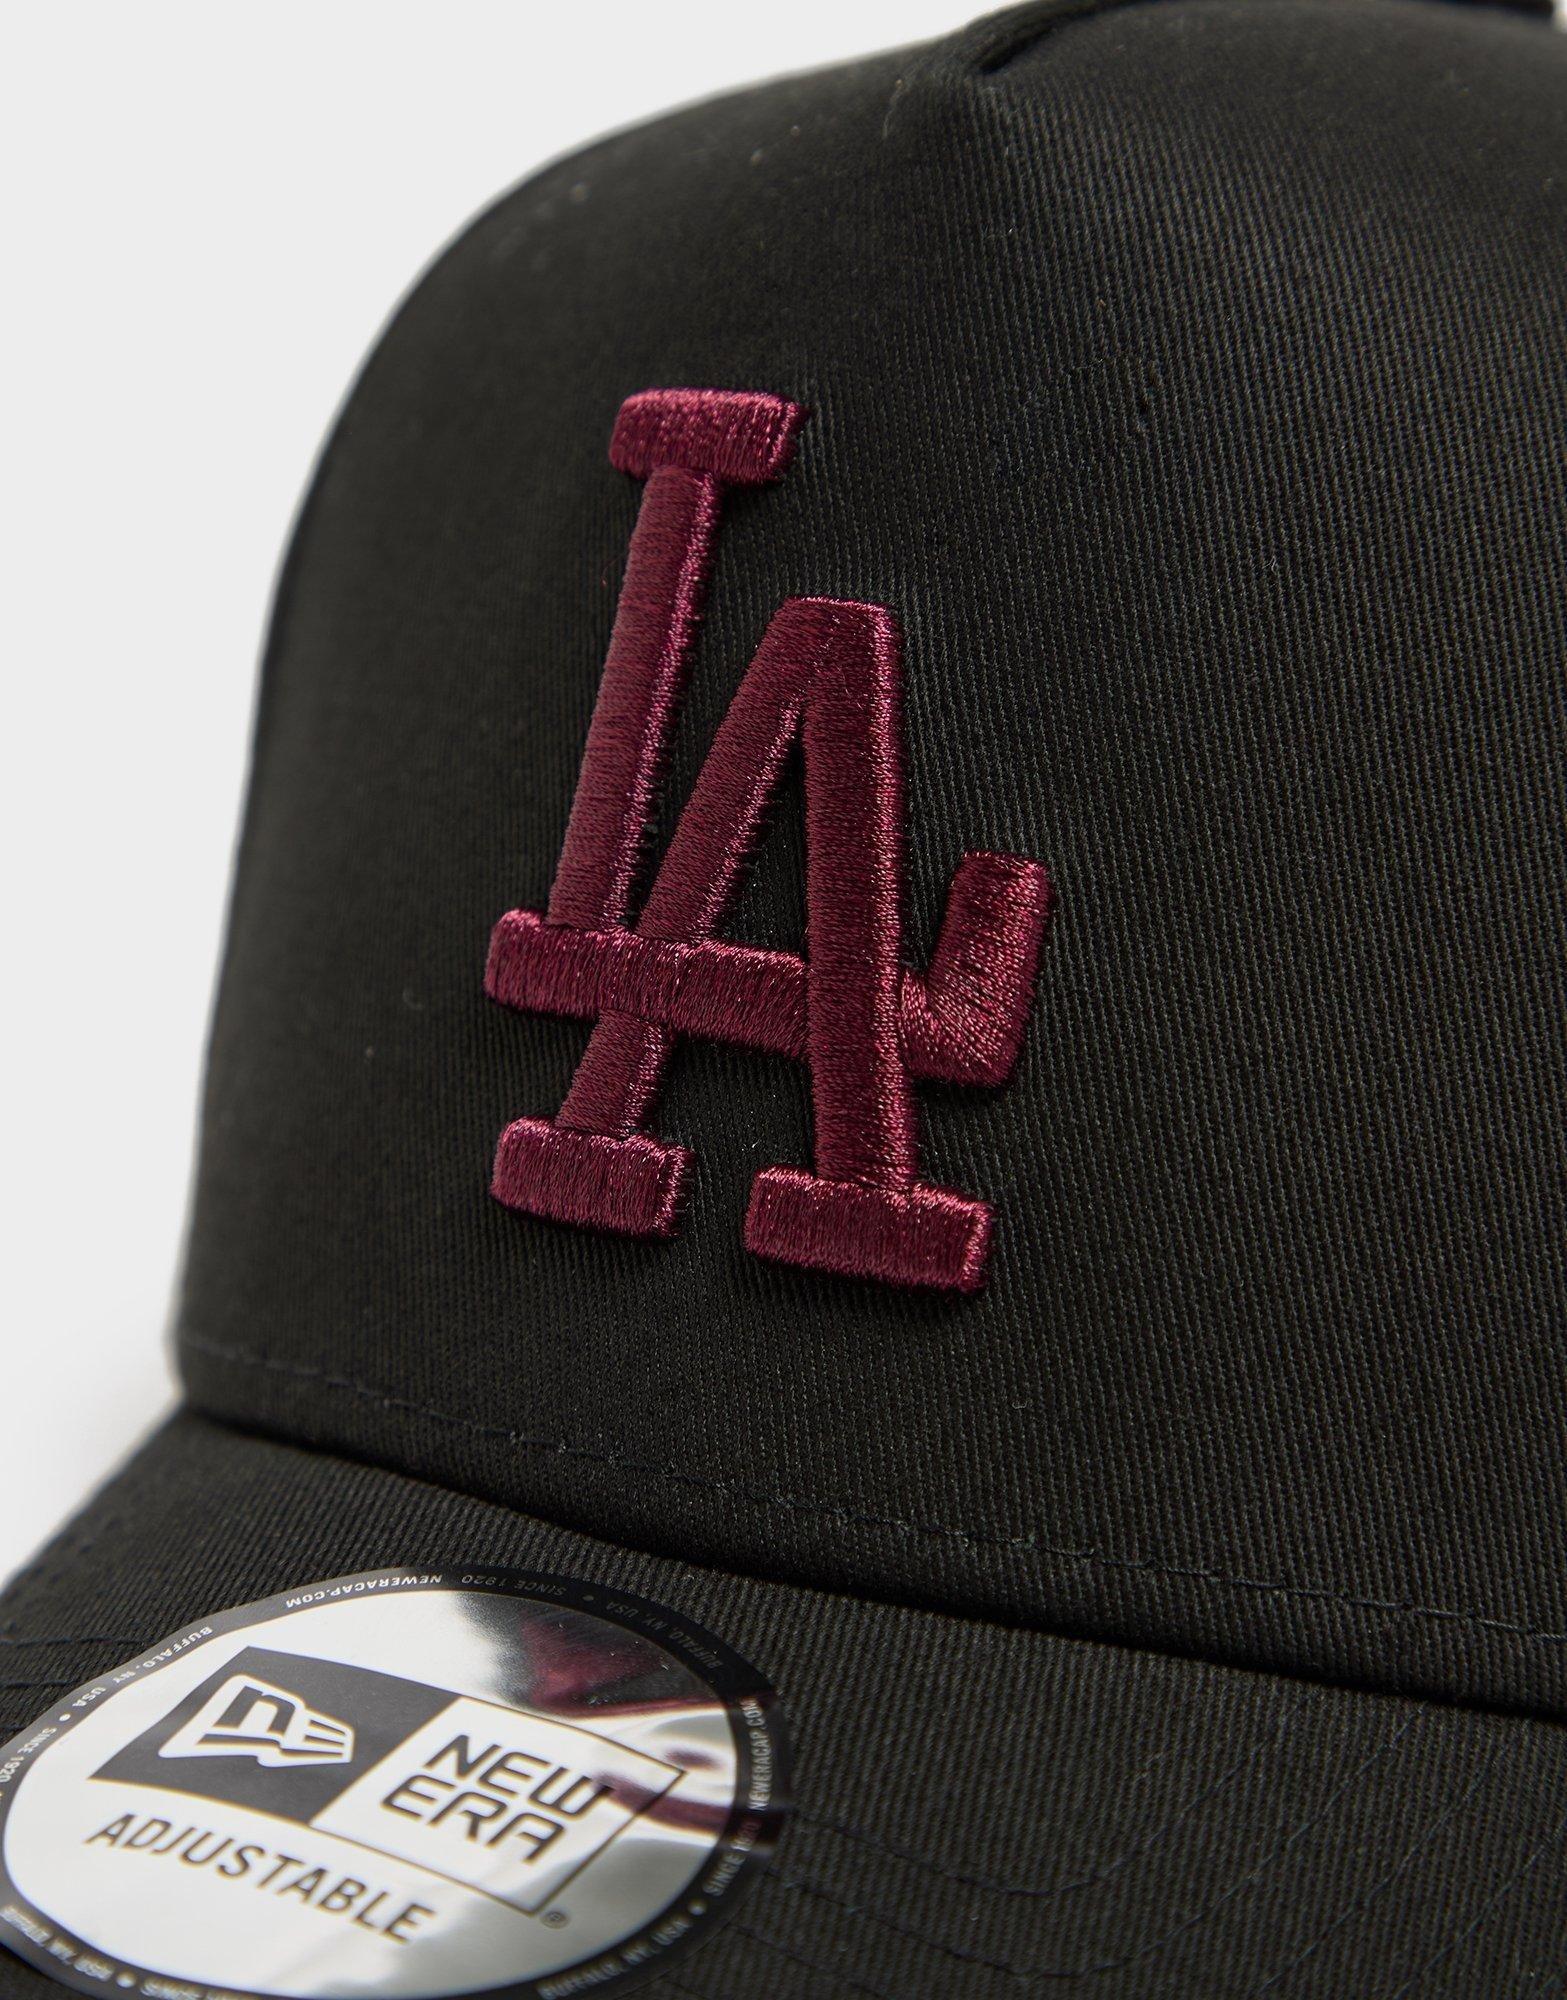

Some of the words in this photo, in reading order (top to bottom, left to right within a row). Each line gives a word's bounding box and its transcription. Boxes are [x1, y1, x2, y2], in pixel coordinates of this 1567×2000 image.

[285, 1573, 443, 1608] NEWERACAP.COM
[461, 1573, 506, 1589] 1920
[514, 1577, 567, 1597] SINCE
[72, 1686, 107, 1708] USA
[423, 1734, 615, 1822] NEW
[380, 1774, 567, 1865] ERA
[83, 1812, 439, 1946] ADJUSTABLE
